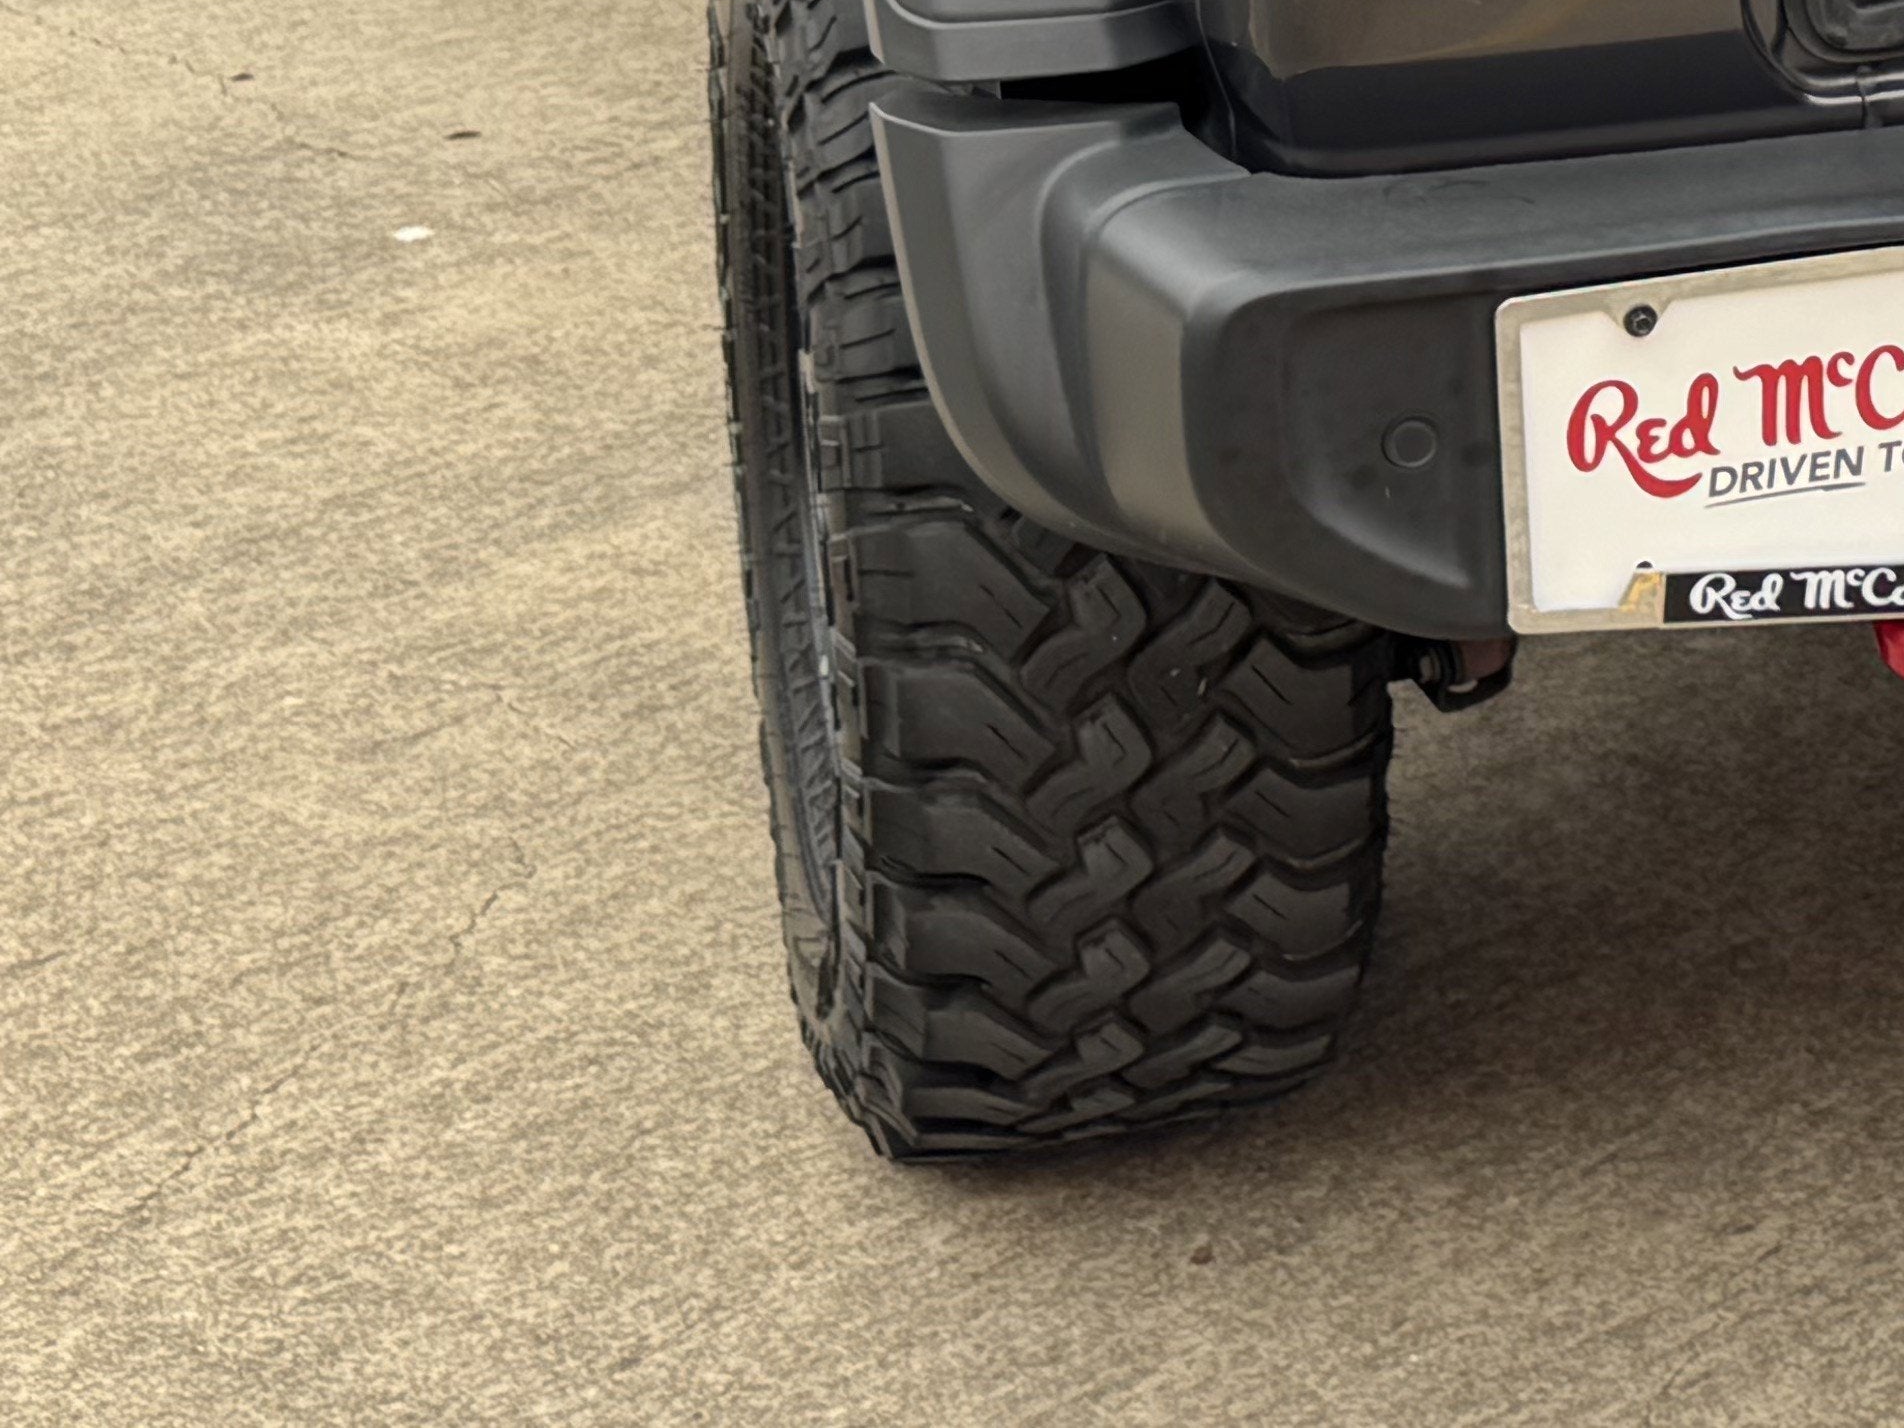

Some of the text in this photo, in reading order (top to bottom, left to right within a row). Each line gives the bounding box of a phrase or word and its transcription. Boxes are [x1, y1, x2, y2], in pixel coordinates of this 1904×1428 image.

[1566, 372, 1722, 499] Red
[1707, 445, 1867, 500] DRIVEN
[1688, 571, 1783, 621] Red
